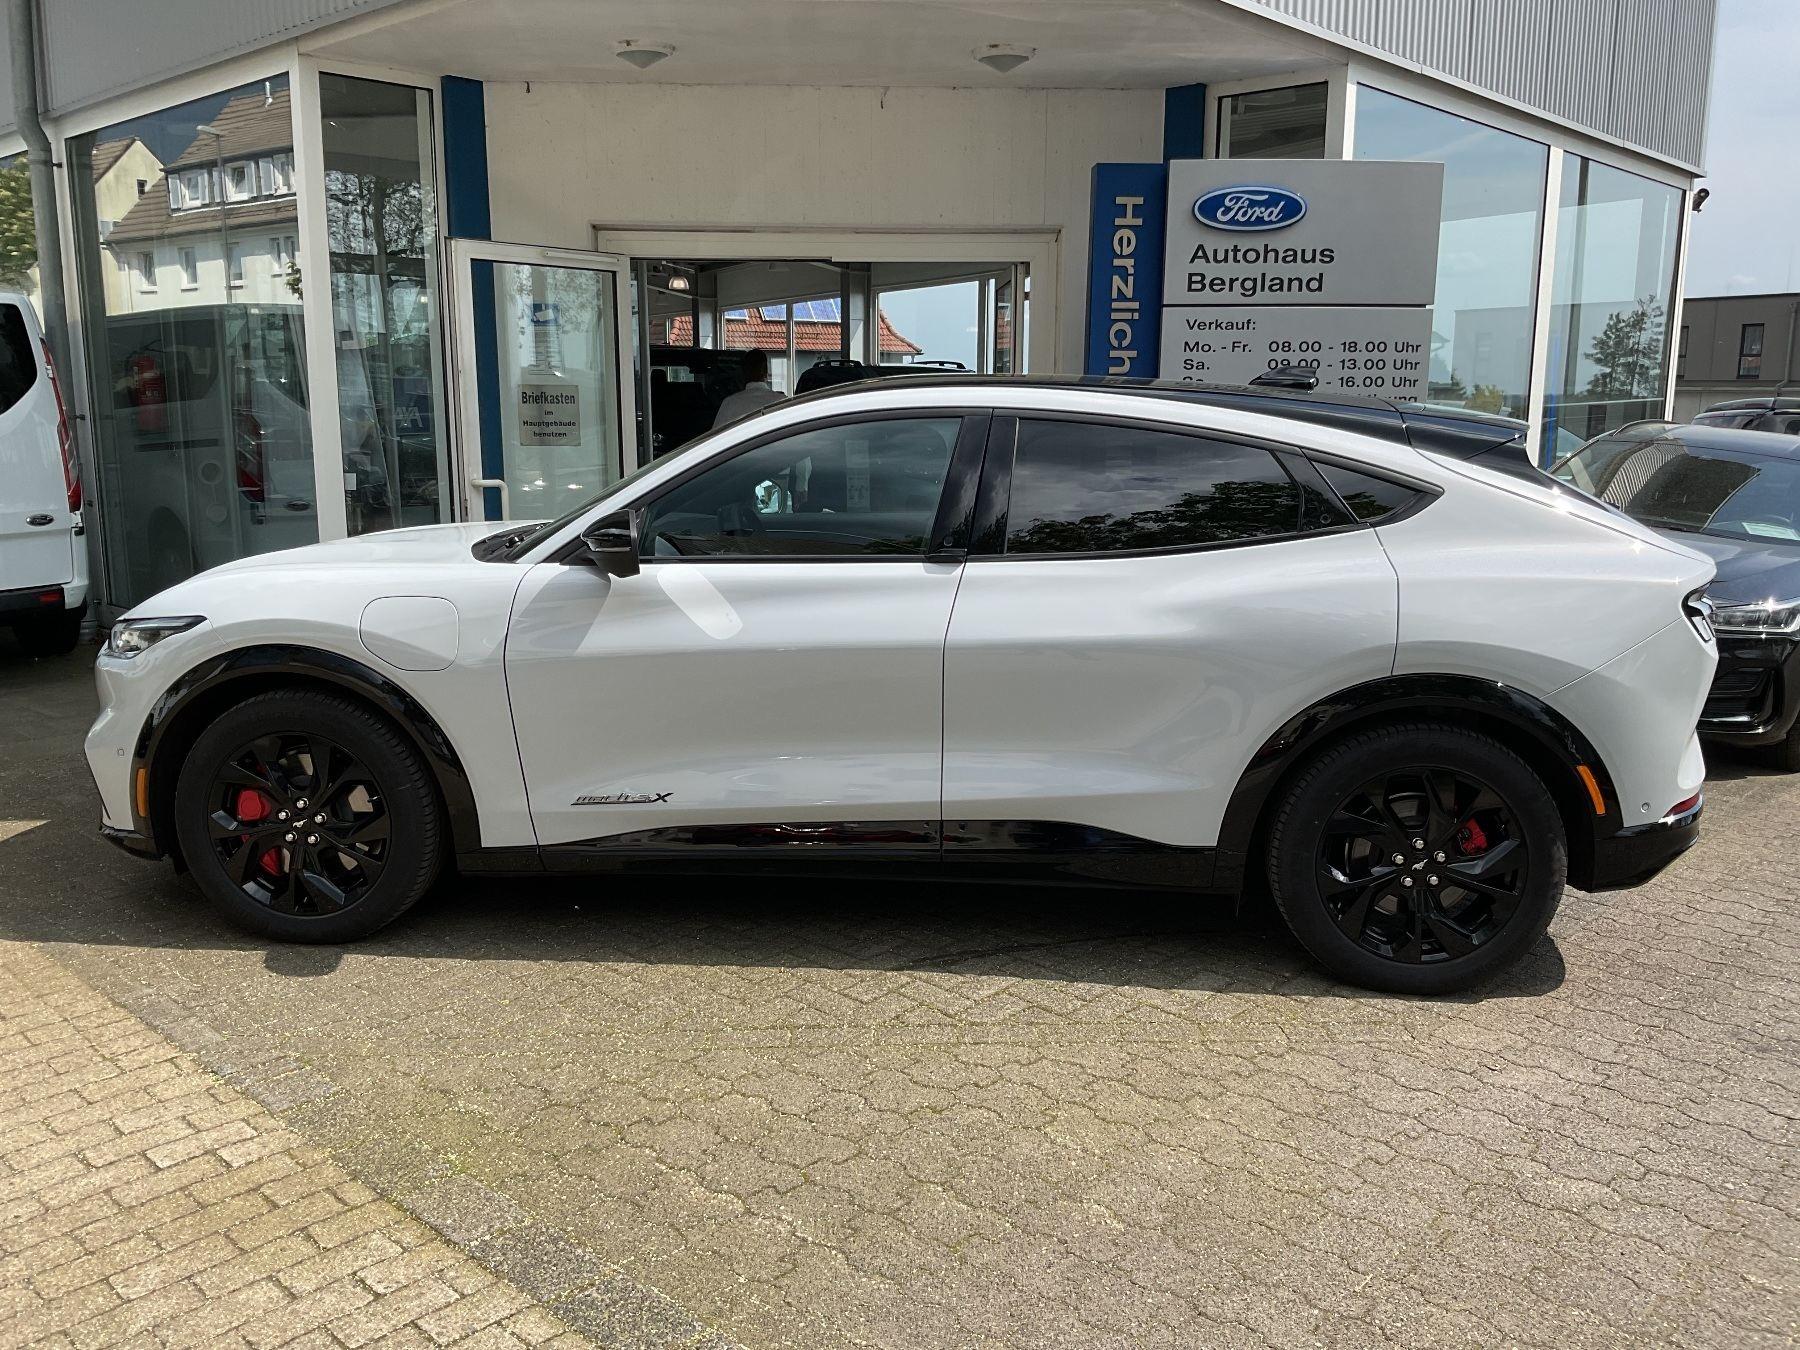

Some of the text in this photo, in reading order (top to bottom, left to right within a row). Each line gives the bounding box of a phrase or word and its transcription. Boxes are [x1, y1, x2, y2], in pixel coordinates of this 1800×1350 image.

[1216, 193, 1286, 222] Ford
[1189, 244, 1335, 265] Autohaus
[1108, 196, 1144, 375] Herzlich
[1186, 272, 1324, 298] Bergland
[1185, 318, 1256, 331] Verkauf:
[1183, 341, 1217, 353] Mo.
[1231, 341, 1252, 353] Fr.
[1268, 340, 1322, 353] 08.00
[1340, 341, 1388, 353] 18.00
[1394, 341, 1422, 353] Uhr
[1183, 358, 1210, 371] Sa.
[1339, 358, 1386, 371] 13.00
[1393, 358, 1421, 371] Uhr
[1338, 376, 1385, 388] 16.00
[1391, 376, 1419, 388] Uhr
[521, 391, 576, 405] Briefkasten
